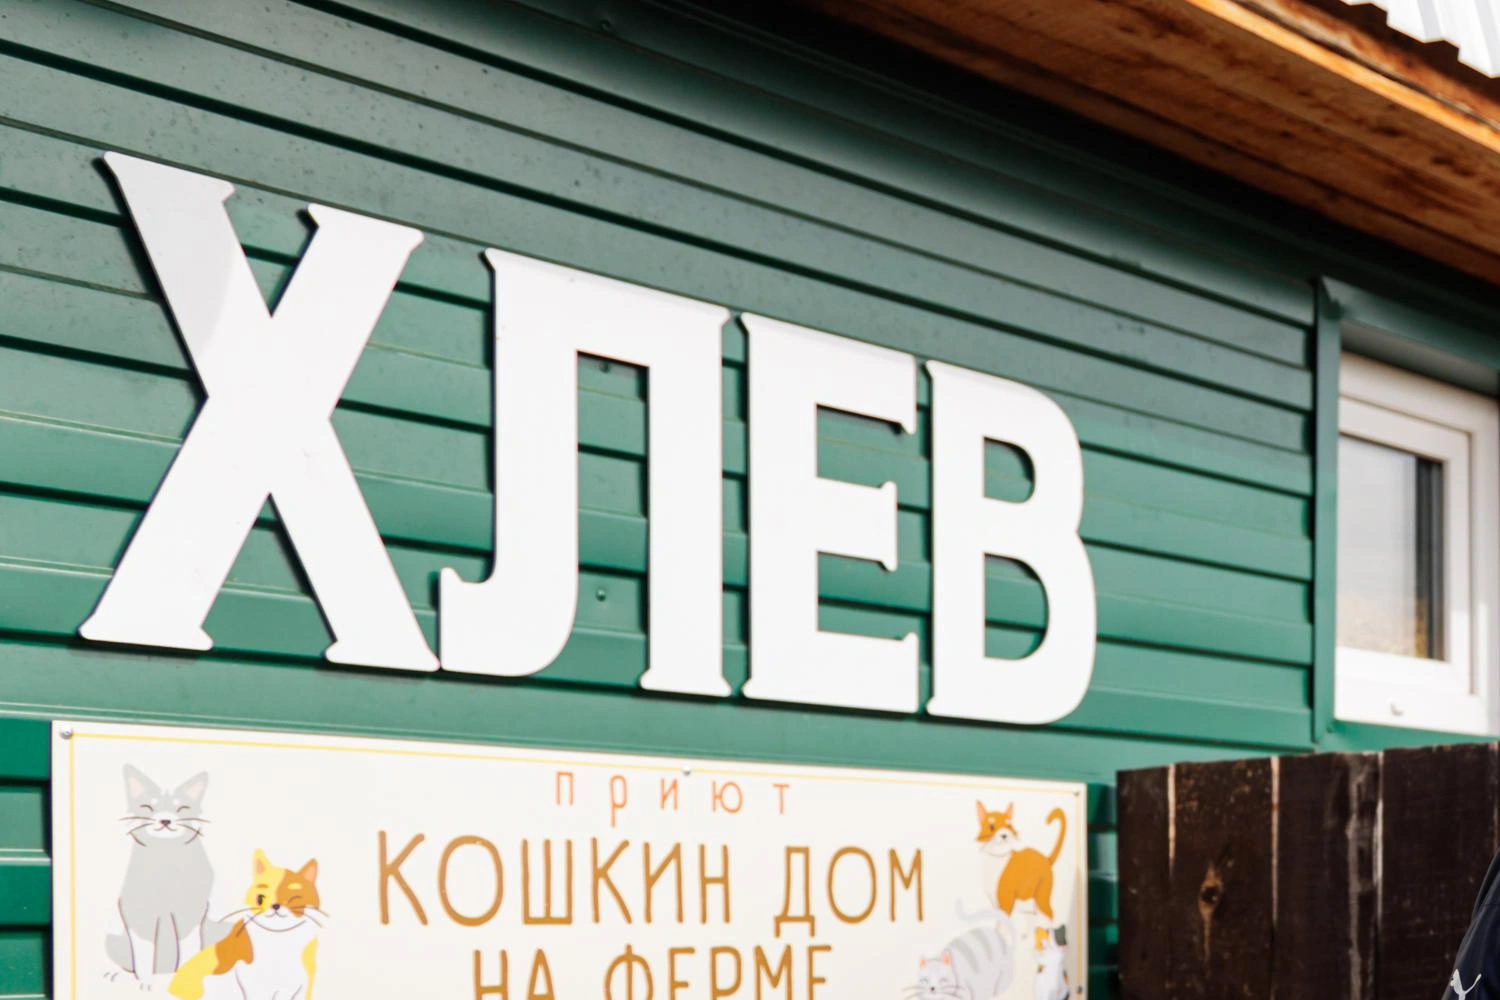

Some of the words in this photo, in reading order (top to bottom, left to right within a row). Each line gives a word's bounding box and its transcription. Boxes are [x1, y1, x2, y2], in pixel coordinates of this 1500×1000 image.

[79, 151, 1098, 726] ХЛЕВ
[554, 771, 790, 828] приют
[377, 830, 731, 927] КОШКИН
[773, 845, 924, 938] ДОМ
